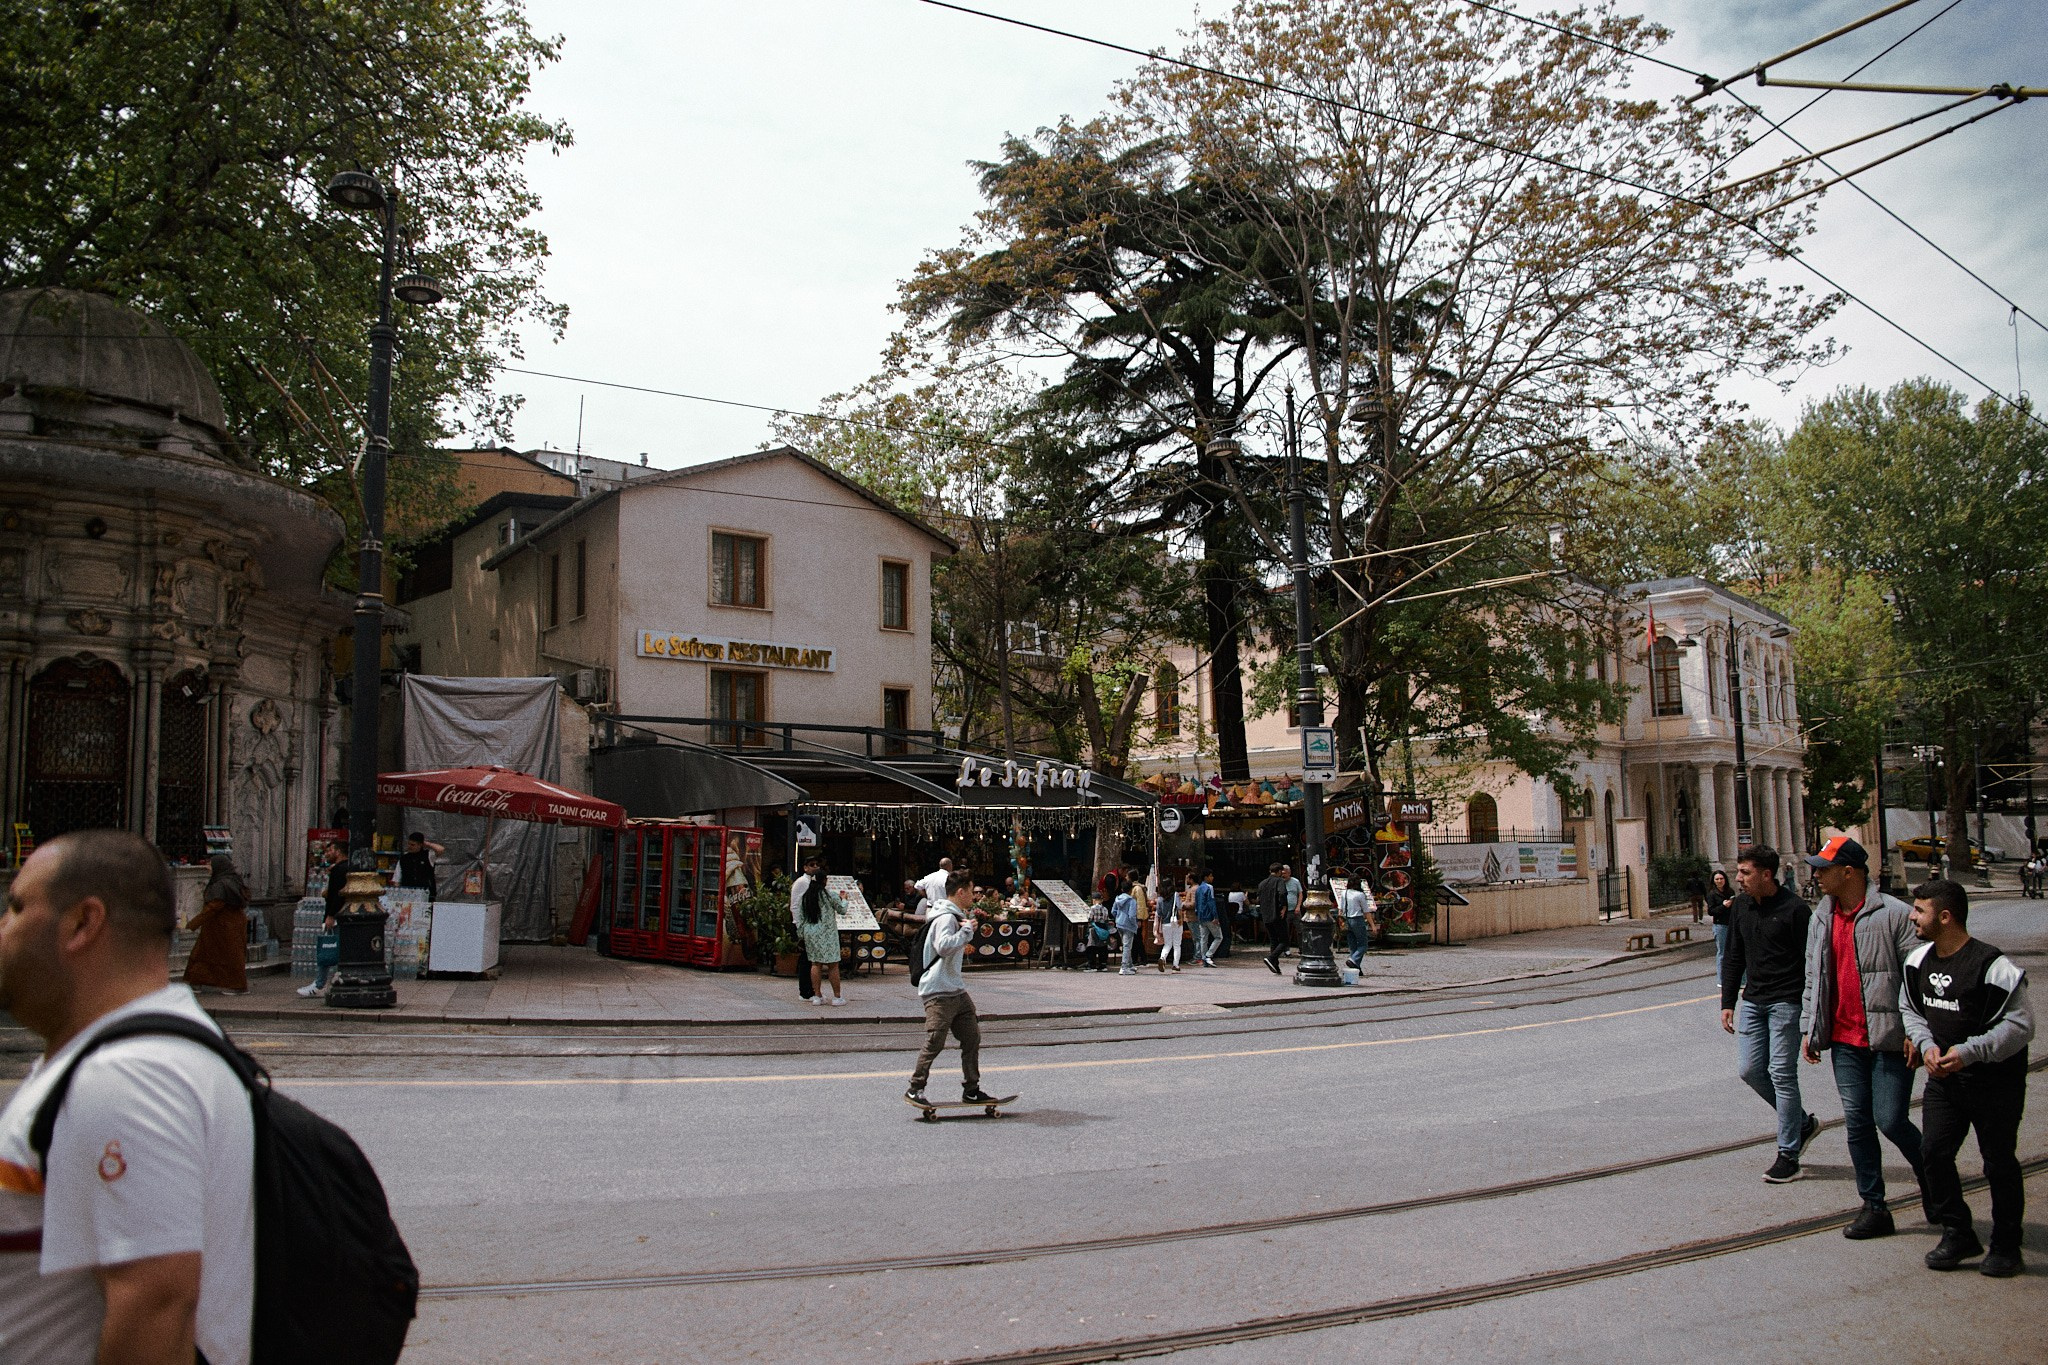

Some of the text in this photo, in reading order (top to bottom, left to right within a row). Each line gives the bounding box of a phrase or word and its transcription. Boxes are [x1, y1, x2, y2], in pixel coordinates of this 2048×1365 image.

[645, 633, 832, 669] Le Safran RESTAURANT
[956, 757, 1091, 797] Le Safran
[548, 803, 578, 818] TADINI
[579, 805, 608, 821] ÇIKAR
[1922, 993, 1960, 1012] hummel
